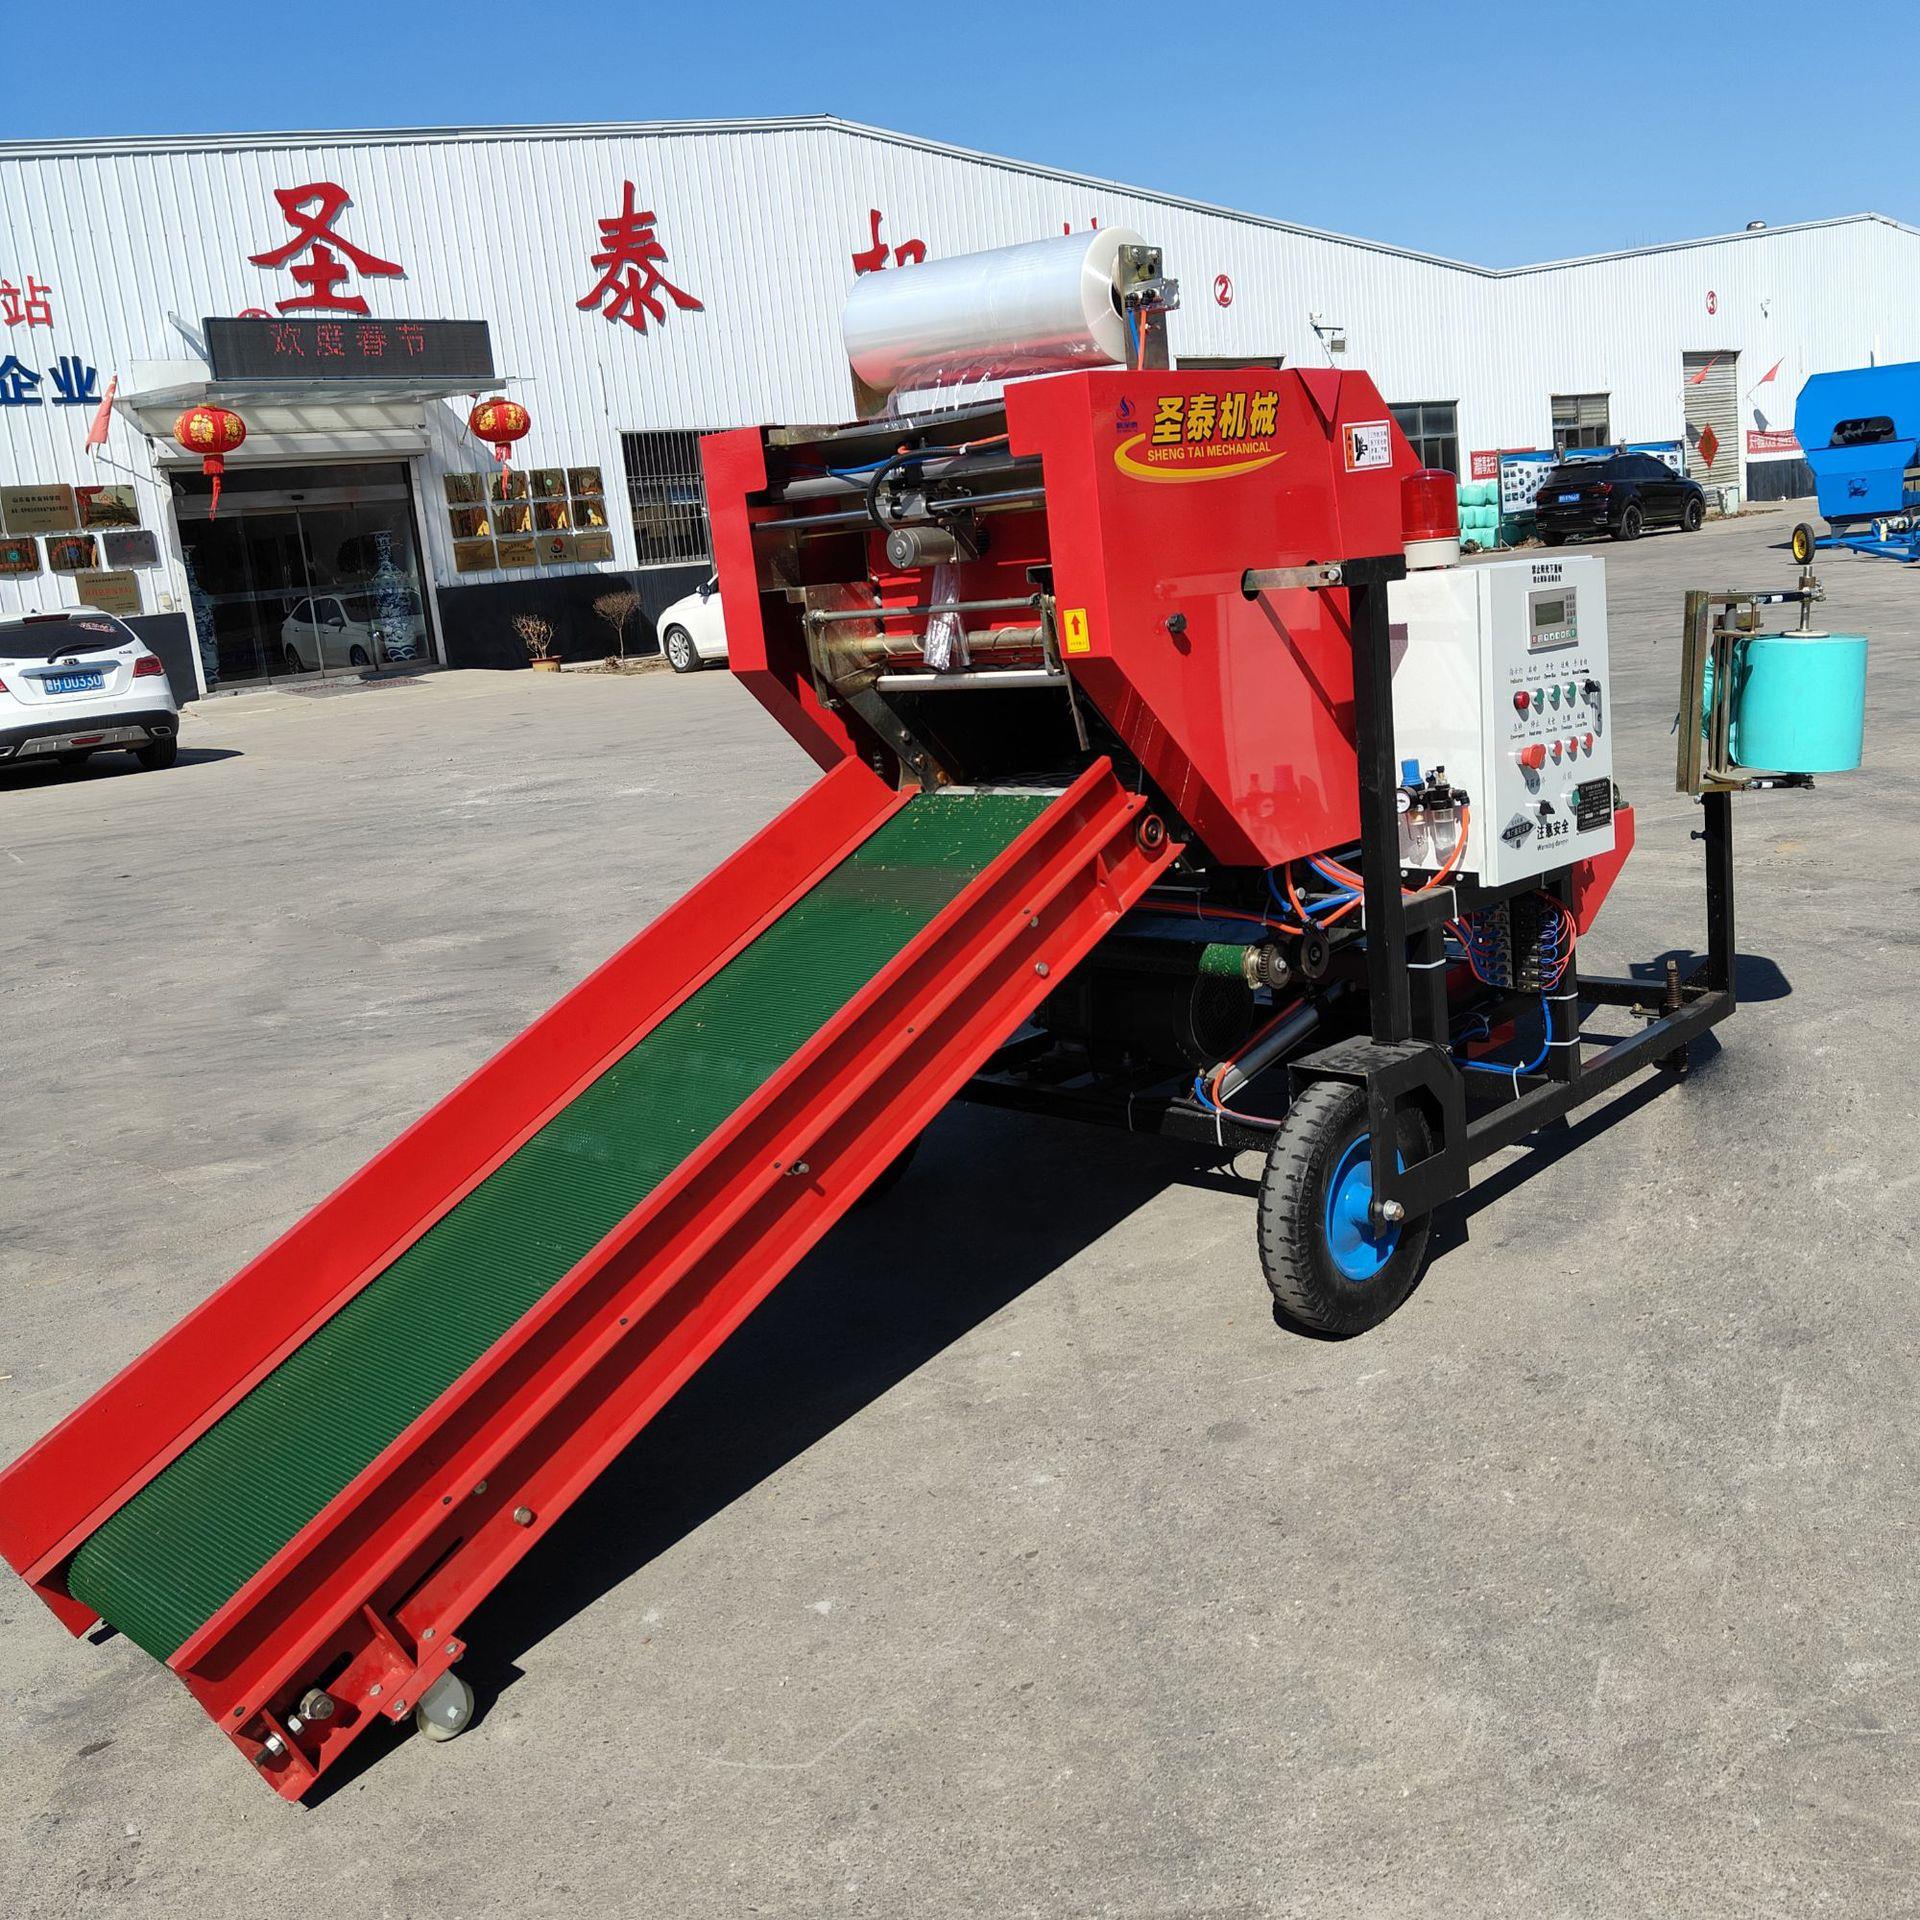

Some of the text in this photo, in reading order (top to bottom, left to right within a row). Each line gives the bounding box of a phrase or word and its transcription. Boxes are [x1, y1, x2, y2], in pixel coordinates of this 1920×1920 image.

[270, 322, 425, 357] 欢度春节
[0, 355, 102, 406] 企业
[1151, 390, 1278, 445] 圣泰机械
[1147, 441, 1271, 462] SHENG TAI MECHANICAL
[1537, 819, 1569, 840] 注意安全
